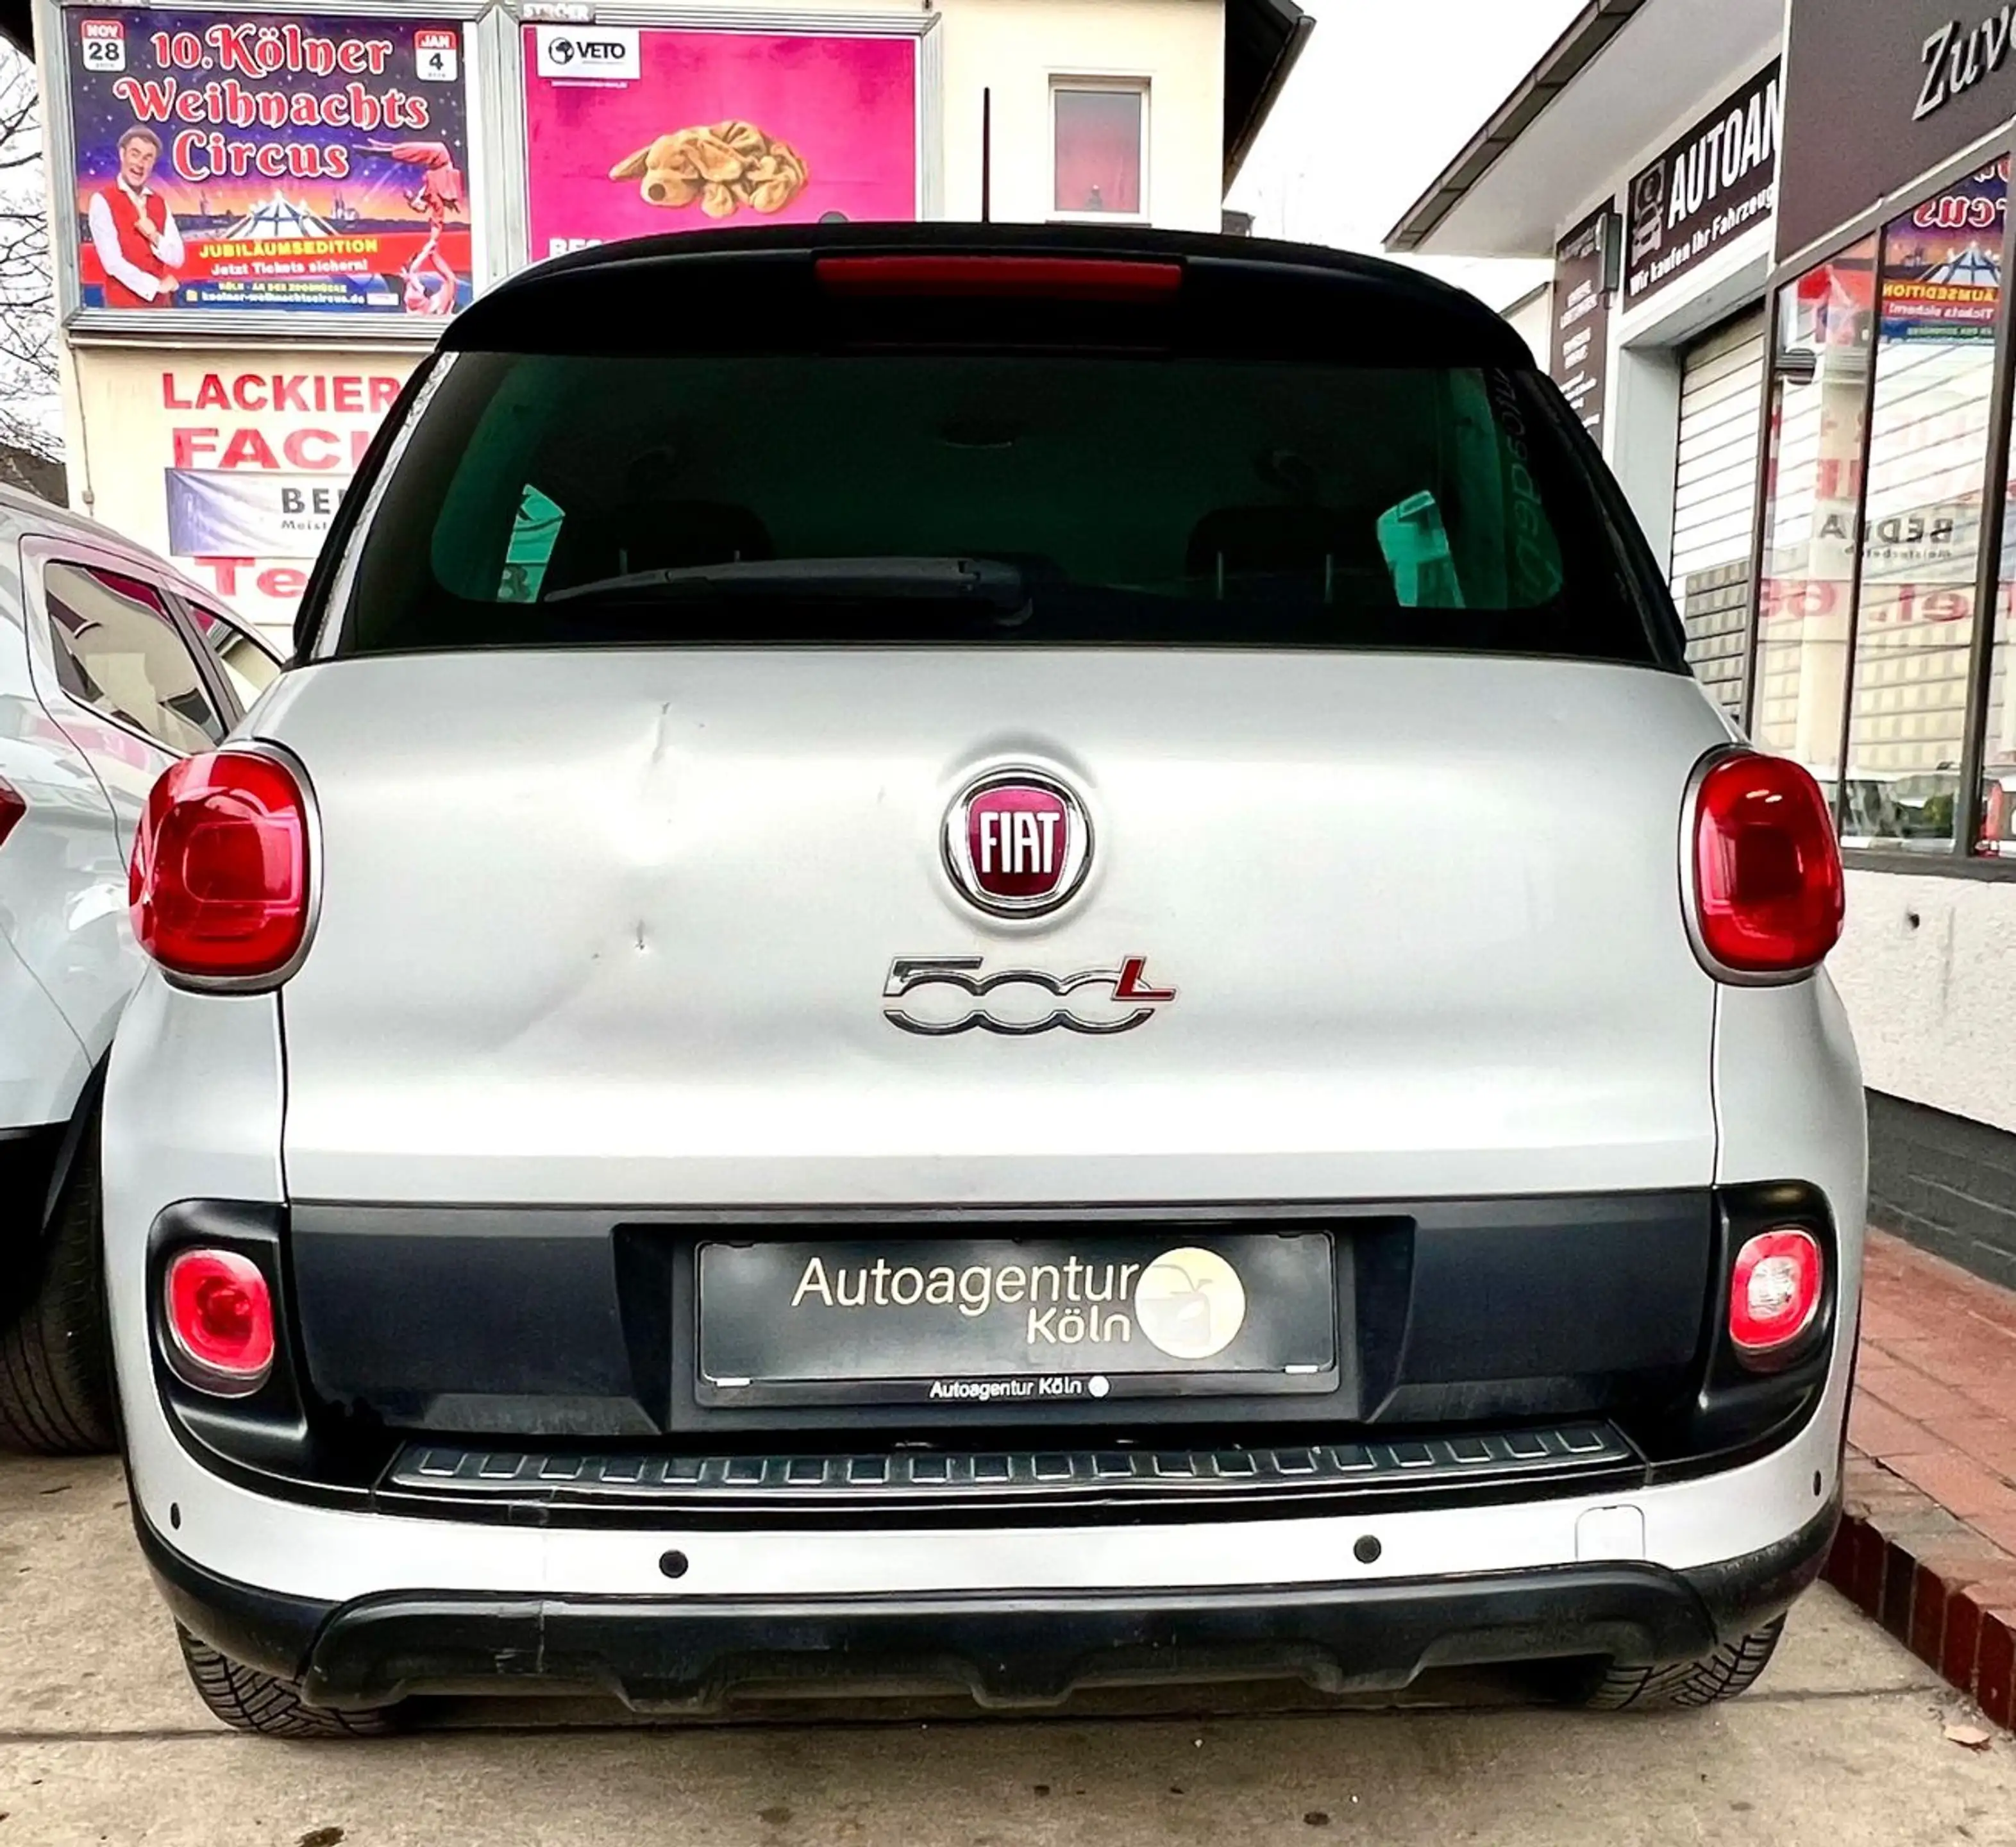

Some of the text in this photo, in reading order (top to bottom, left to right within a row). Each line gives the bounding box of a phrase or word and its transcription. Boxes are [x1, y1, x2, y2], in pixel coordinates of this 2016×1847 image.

[86, 24, 118, 38] NOV
[419, 35, 449, 49] JAN
[88, 42, 120, 61] 28
[205, 23, 392, 78] Kölner
[429, 52, 444, 71] 4
[576, 42, 626, 59] VETO
[113, 76, 430, 131] Weihnachts
[172, 128, 349, 181] Circus
[199, 239, 378, 258] JUBILÄUMSEDITION
[549, 239, 603, 257] BE
[1629, 270, 1649, 296] Wir
[1650, 242, 1691, 283] kaufen
[1692, 228, 1711, 255] Ihr
[211, 258, 368, 276] Jetzt Tickets sichern!
[162, 372, 401, 413] LACKIER
[281, 487, 347, 515] BE
[193, 557, 308, 598] Te
[979, 811, 1061, 873] FIAT
[883, 956, 1177, 1036] 500L
[790, 1256, 1140, 1317] Autoagentur
[1027, 1306, 1132, 1344] Köln
[929, 1378, 1082, 1401] Autoagentur Köln
